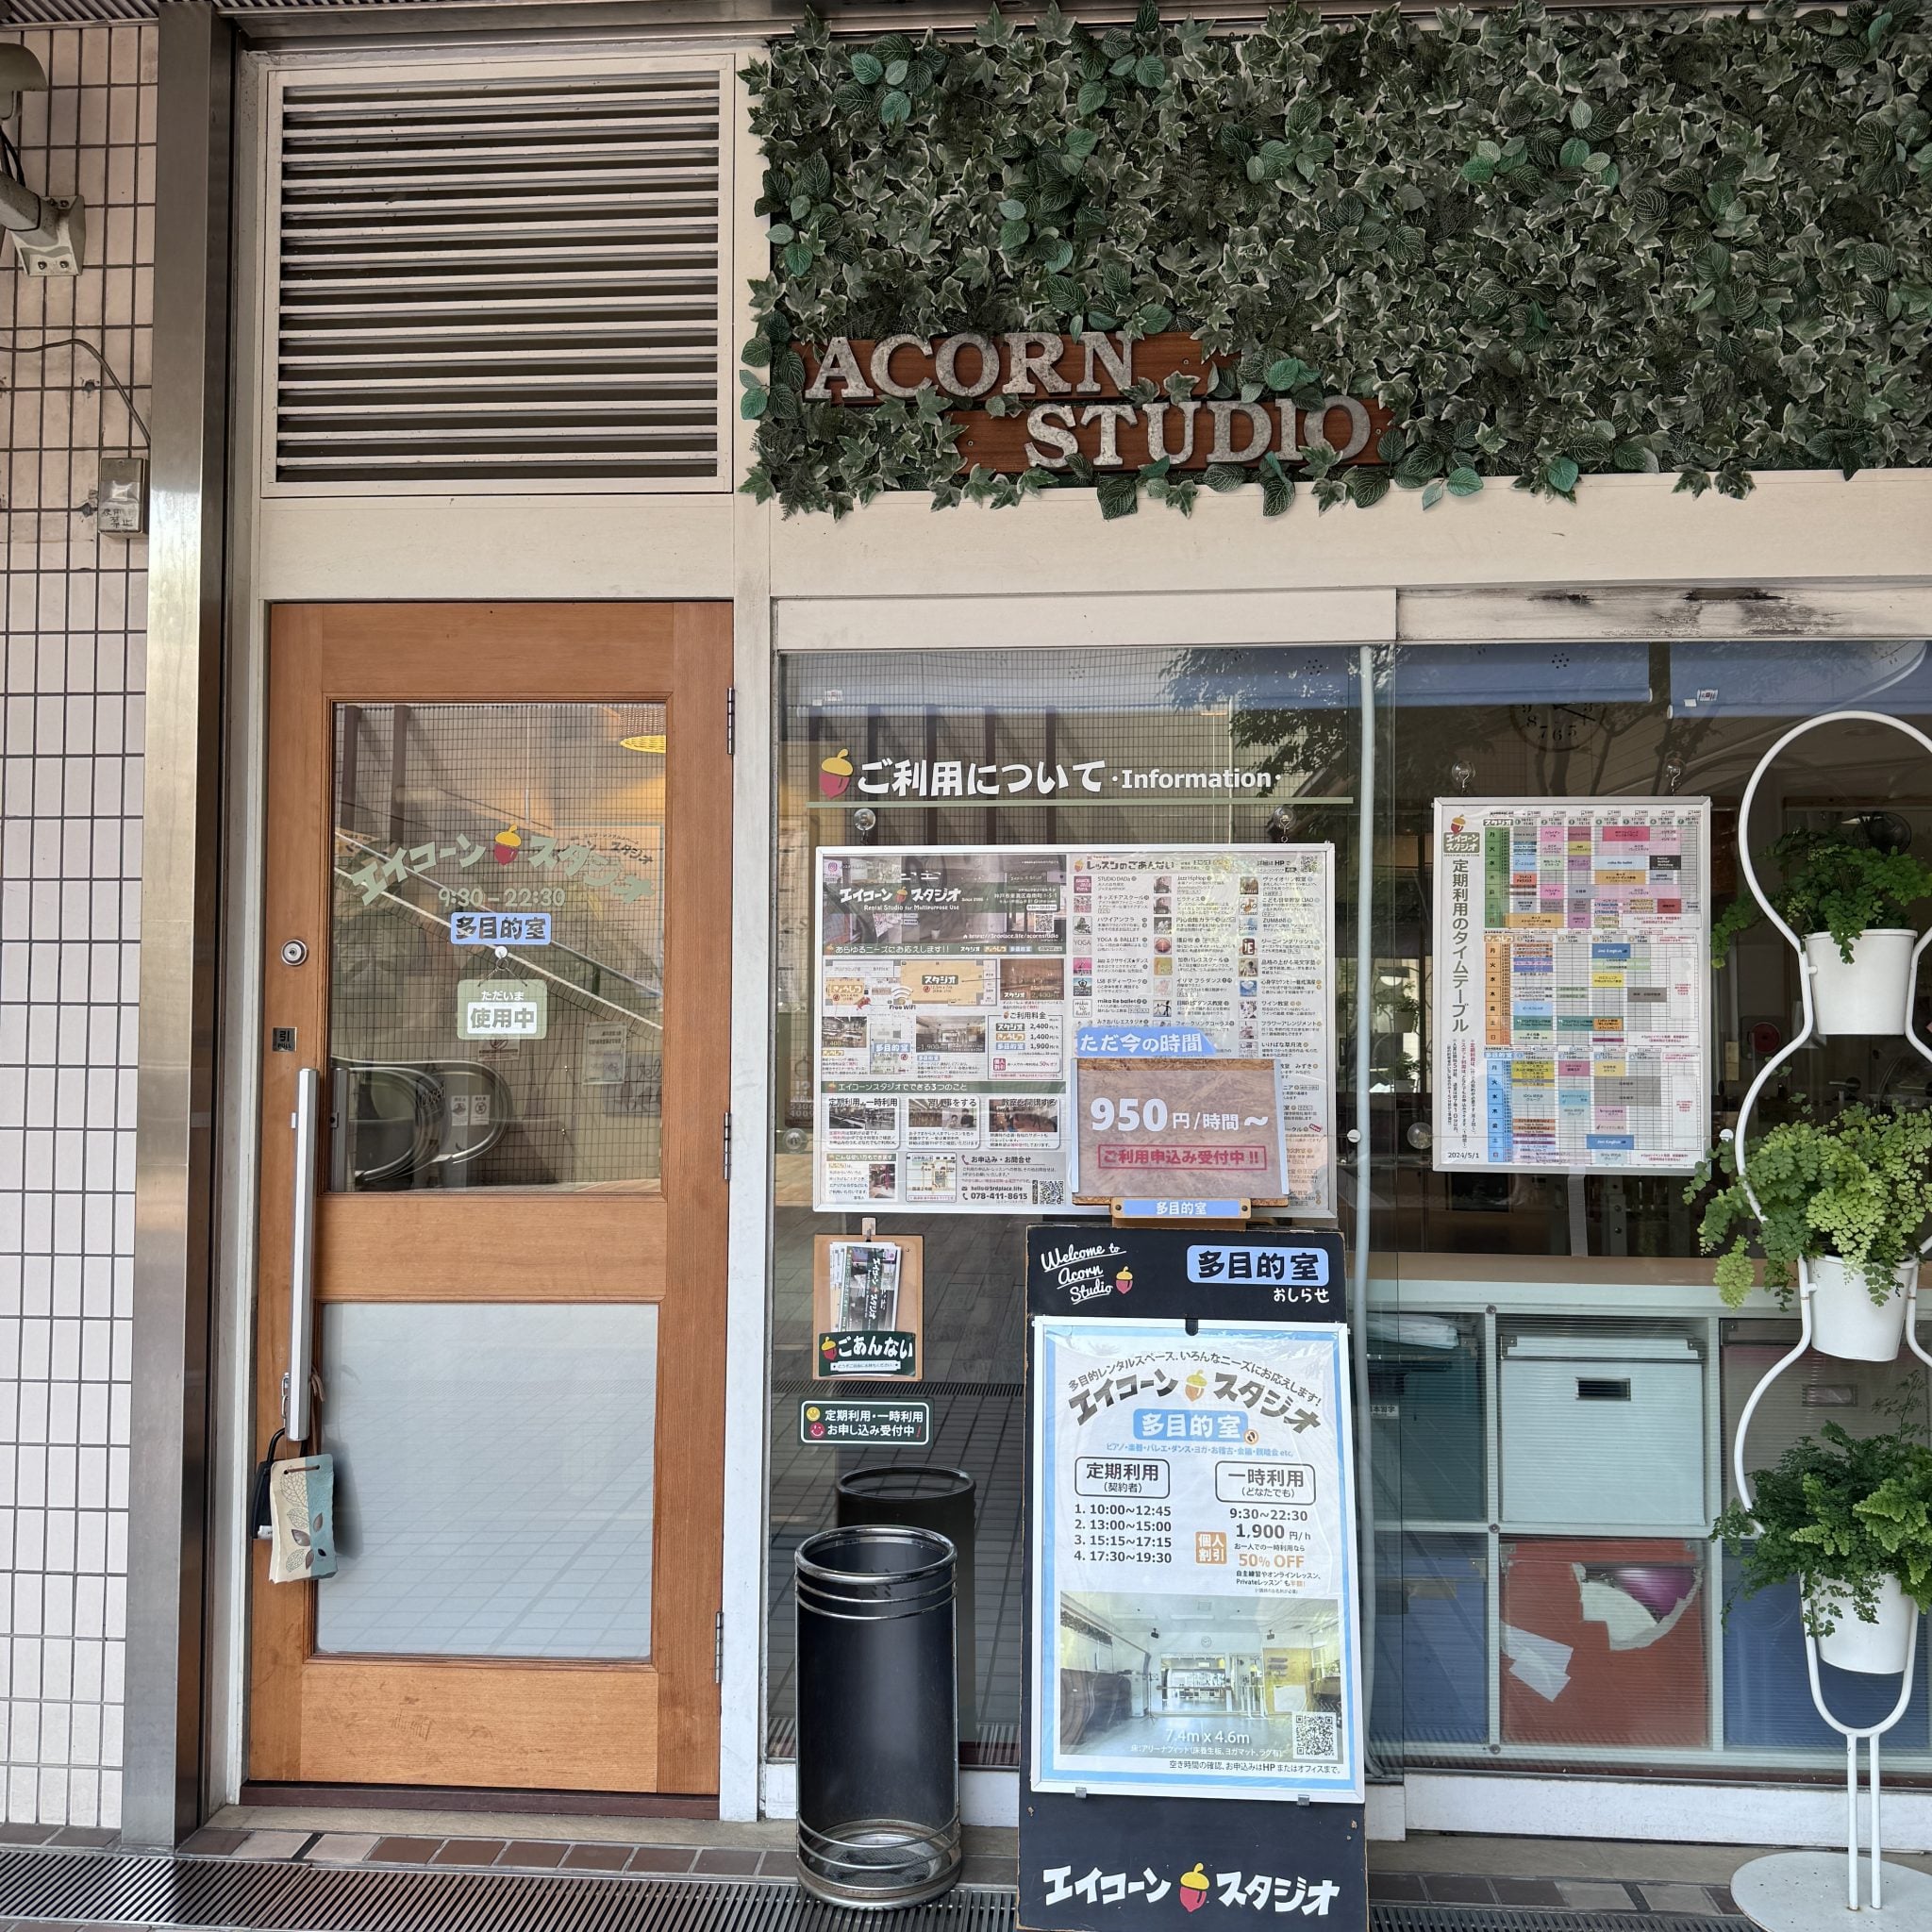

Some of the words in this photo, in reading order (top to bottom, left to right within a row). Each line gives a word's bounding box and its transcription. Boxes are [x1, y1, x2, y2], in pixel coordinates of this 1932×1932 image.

[805, 331, 1133, 399] ACORN
[1025, 394, 1372, 469] STUDIO
[858, 758, 1107, 797] ご利用について
[1446, 834, 1479, 843] エイコーン
[1445, 842, 1477, 851] スタジオ
[351, 833, 486, 906] エイコーン
[528, 836, 656, 907] スタジオ
[1087, 859, 1174, 870] レッスンのごあんない
[840, 889, 892, 903] エイコーン
[911, 888, 962, 903] スタジオ
[456, 916, 547, 941] 多目的室
[1452, 859, 1469, 1033] 定期利用のタイムテーブル
[924, 975, 957, 984] スタジオ
[481, 990, 525, 1002] ただいま
[470, 1008, 536, 1029] 使用中
[1080, 1033, 1203, 1054] ただ今の時間
[838, 1082, 968, 1091] エイコーンスタジオでできる3つのこと
[928, 1098, 977, 1108] 習い事をする
[1156, 1202, 1207, 1216] 多目的室
[1041, 1244, 1106, 1271] Welcome
[1198, 1250, 1320, 1281] 多目的室
[1058, 1262, 1104, 1285] Acorn
[1070, 1278, 1114, 1302] Studio
[1274, 1288, 1330, 1304] おしらせ
[838, 1335, 913, 1359] ごあんない
[1069, 1368, 1179, 1426] エイコーン
[1213, 1372, 1322, 1434] スタジオ
[824, 1409, 924, 1423] 定期利用・一時利用
[1141, 1413, 1241, 1438] 多目的室
[1086, 1463, 1159, 1482] 定期利用
[1228, 1469, 1305, 1488] 一時利用
[1104, 1482, 1142, 1493] (契約者)
[1241, 1488, 1295, 1499] (どなたでも)
[1074, 1504, 1086, 1514] 1.
[1090, 1504, 1172, 1517] 10:00~12:45
[1229, 1507, 1308, 1521] 9:30~22:30
[1074, 1520, 1086, 1529] 2.
[1090, 1520, 1172, 1532] 13:00~15:00
[1235, 1524, 1285, 1541] 1,900
[1074, 1535, 1086, 1545] 3.
[1090, 1535, 1172, 1548] 15:15~17:15
[1198, 1533, 1224, 1548] 個人
[1234, 1543, 1306, 1552] お一人での一時利用なら
[1074, 1550, 1086, 1561] 4.
[1090, 1550, 1172, 1564] 17:30~19:30
[1198, 1548, 1224, 1562] 割引
[1239, 1554, 1271, 1568] 50%
[1274, 1555, 1305, 1568] OFF
[1166, 1728, 1202, 1743] 7.4m
[1204, 1734, 1212, 1743] x
[1215, 1729, 1250, 1744] 4.6m
[1042, 1865, 1172, 1906] エイコーン
[1216, 1871, 1341, 1916] スタジオ
